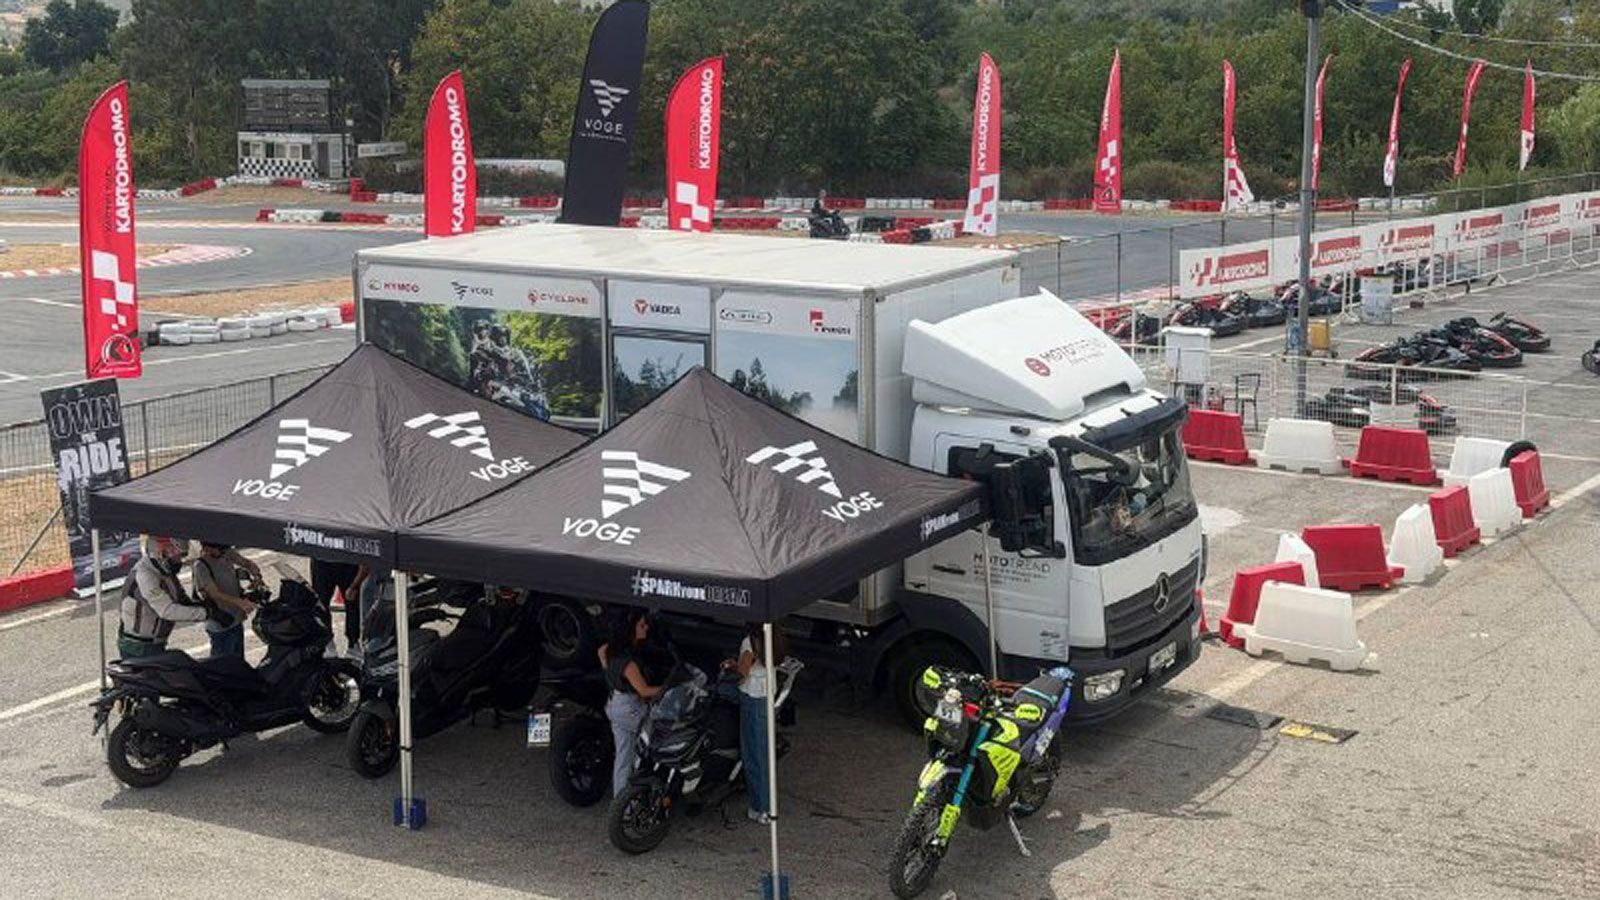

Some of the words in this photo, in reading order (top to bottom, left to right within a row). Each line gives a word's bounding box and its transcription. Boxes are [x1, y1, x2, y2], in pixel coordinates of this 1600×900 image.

[585, 118, 624, 135] VOGE
[699, 67, 714, 170] KARTODROMO
[110, 98, 131, 233] KARTODROMO
[445, 87, 467, 234] KARTODROMO
[50, 393, 121, 439] OWN
[58, 436, 125, 484] RIDE
[470, 456, 536, 483] VOGE
[230, 479, 301, 501] VOGE
[822, 491, 884, 523] VOGE
[562, 517, 642, 546] VOGE
